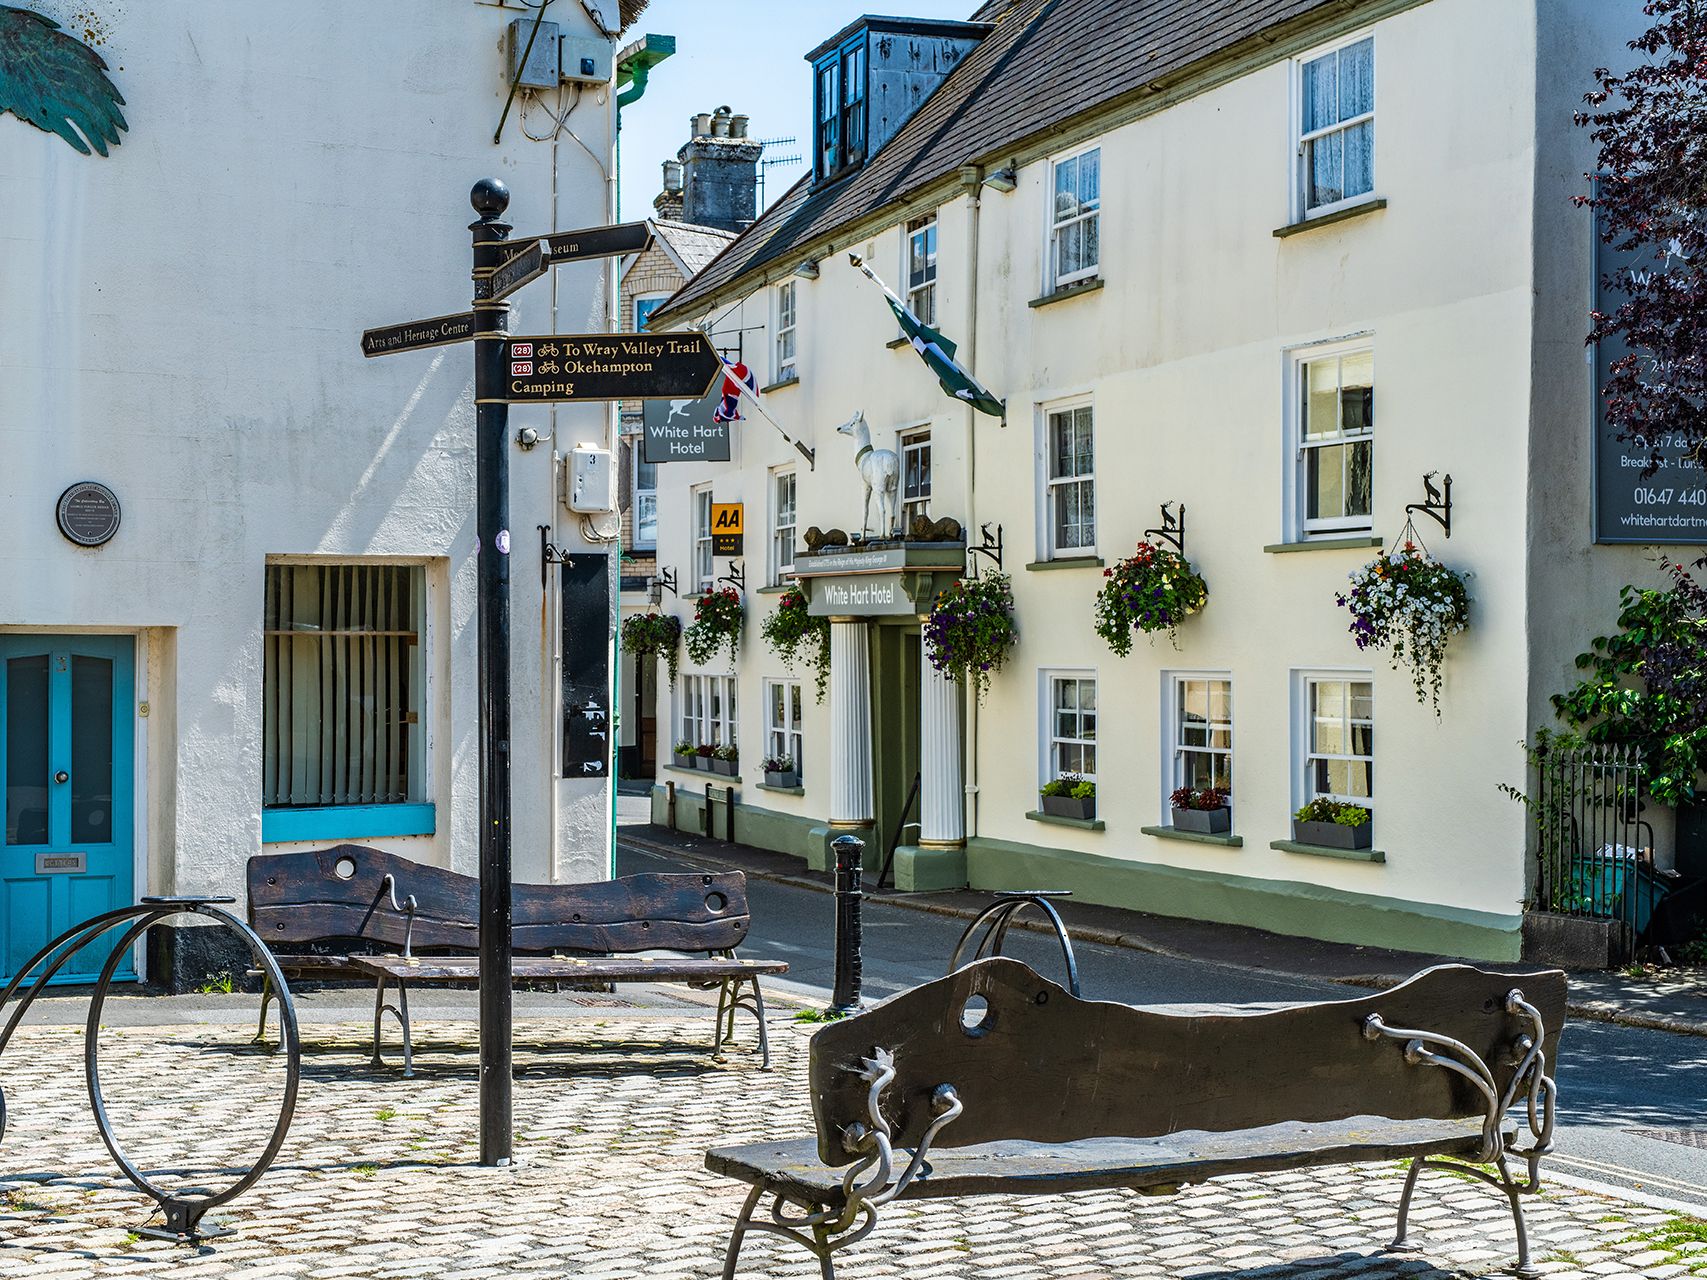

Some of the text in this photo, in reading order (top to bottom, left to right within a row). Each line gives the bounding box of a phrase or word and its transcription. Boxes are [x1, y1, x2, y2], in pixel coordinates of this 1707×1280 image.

[550, 243, 579, 255] seum
[368, 323, 469, 349] Arts and Heritage Centre
[563, 343, 580, 357] To
[583, 343, 619, 358] Wray
[621, 341, 664, 357] Valley
[667, 340, 701, 354] Trail
[564, 360, 653, 376] Okehampton
[511, 380, 575, 396] Camping
[650, 425, 724, 438] White Hart
[670, 442, 705, 454] Hotel
[1634, 435, 1664, 449] Opn
[1665, 436, 1672, 447] 7
[589, 454, 596, 465] 3
[1621, 456, 1668, 468] Breakst
[1634, 488, 1707, 506] 01647 440
[715, 509, 739, 528] AA
[824, 582, 894, 605] White Hart Hotel
